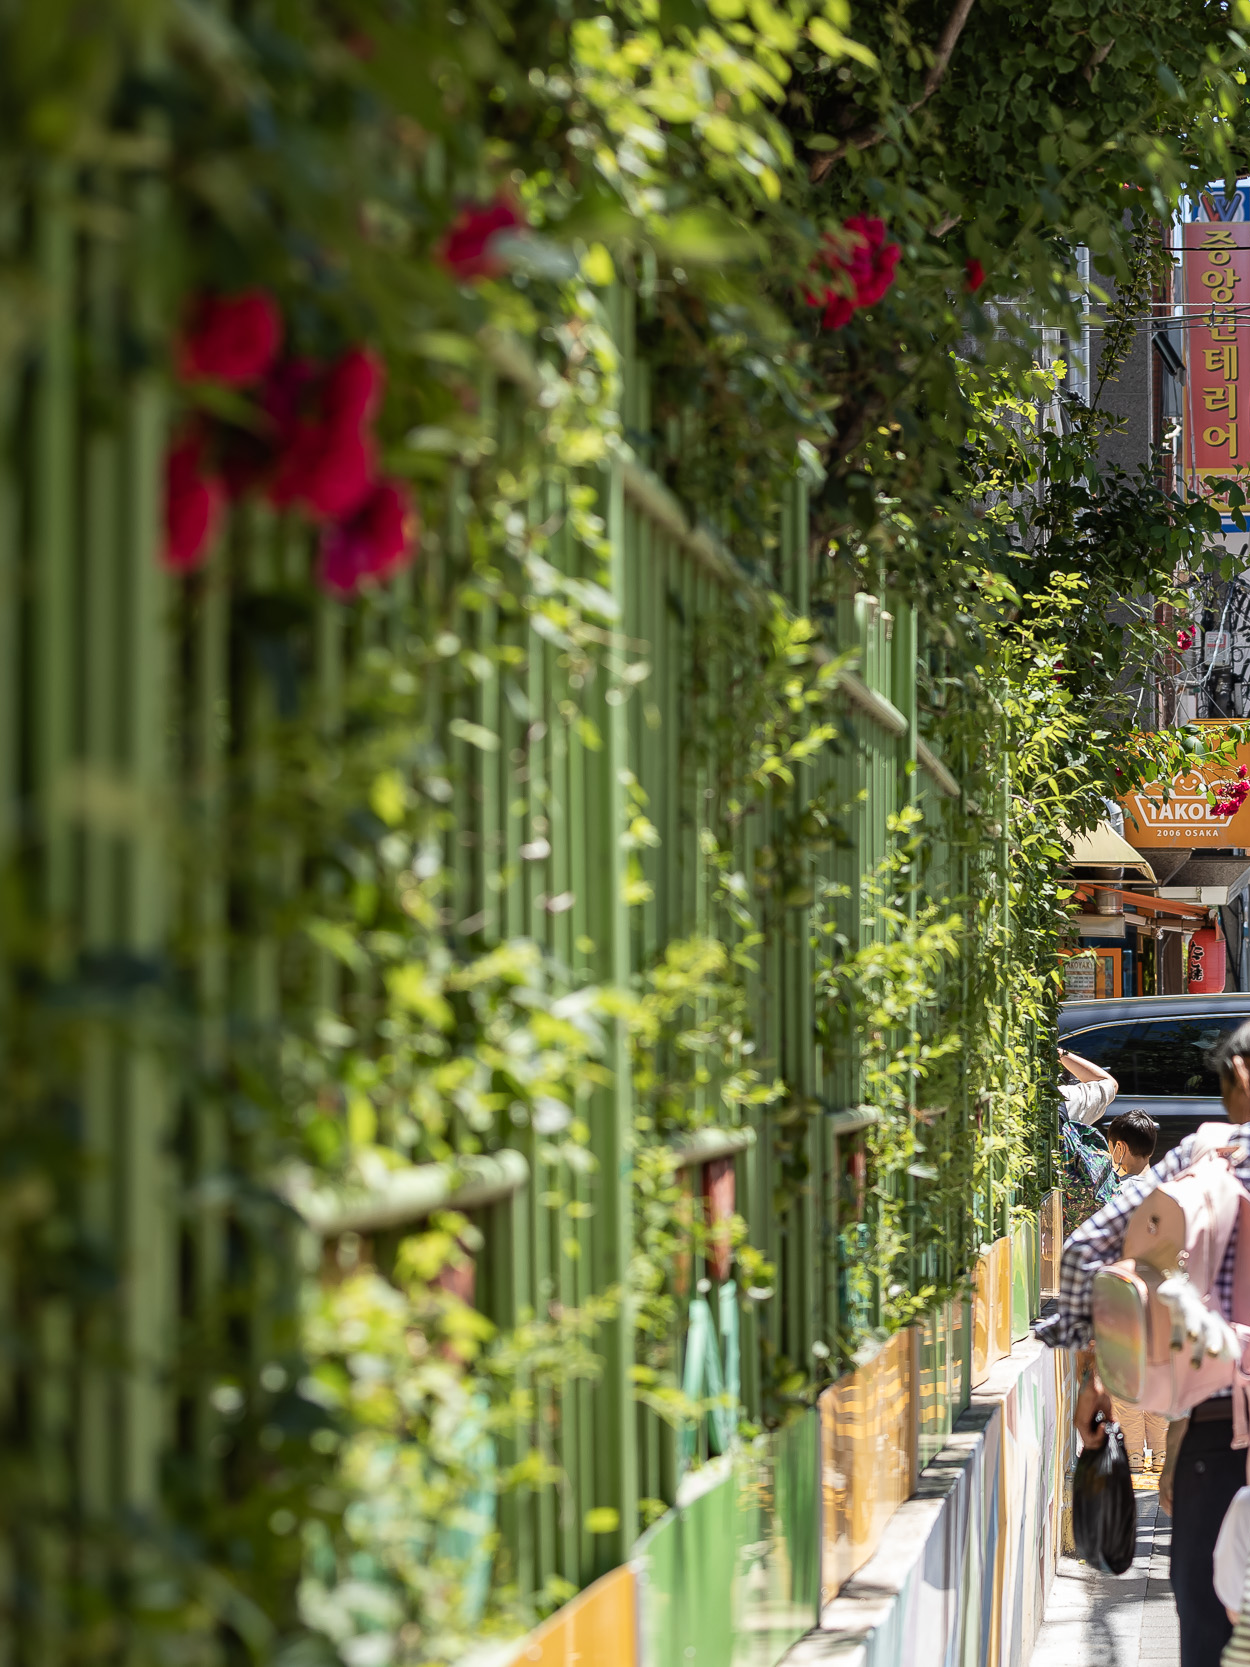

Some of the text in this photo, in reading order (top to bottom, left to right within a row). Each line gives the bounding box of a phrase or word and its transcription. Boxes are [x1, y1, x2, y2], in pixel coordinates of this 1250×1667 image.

[1201, 229, 1241, 459] 중앙인테리어
[1147, 803, 1225, 820] TAKO
[1156, 829, 1219, 837] 2006 OSAKA
